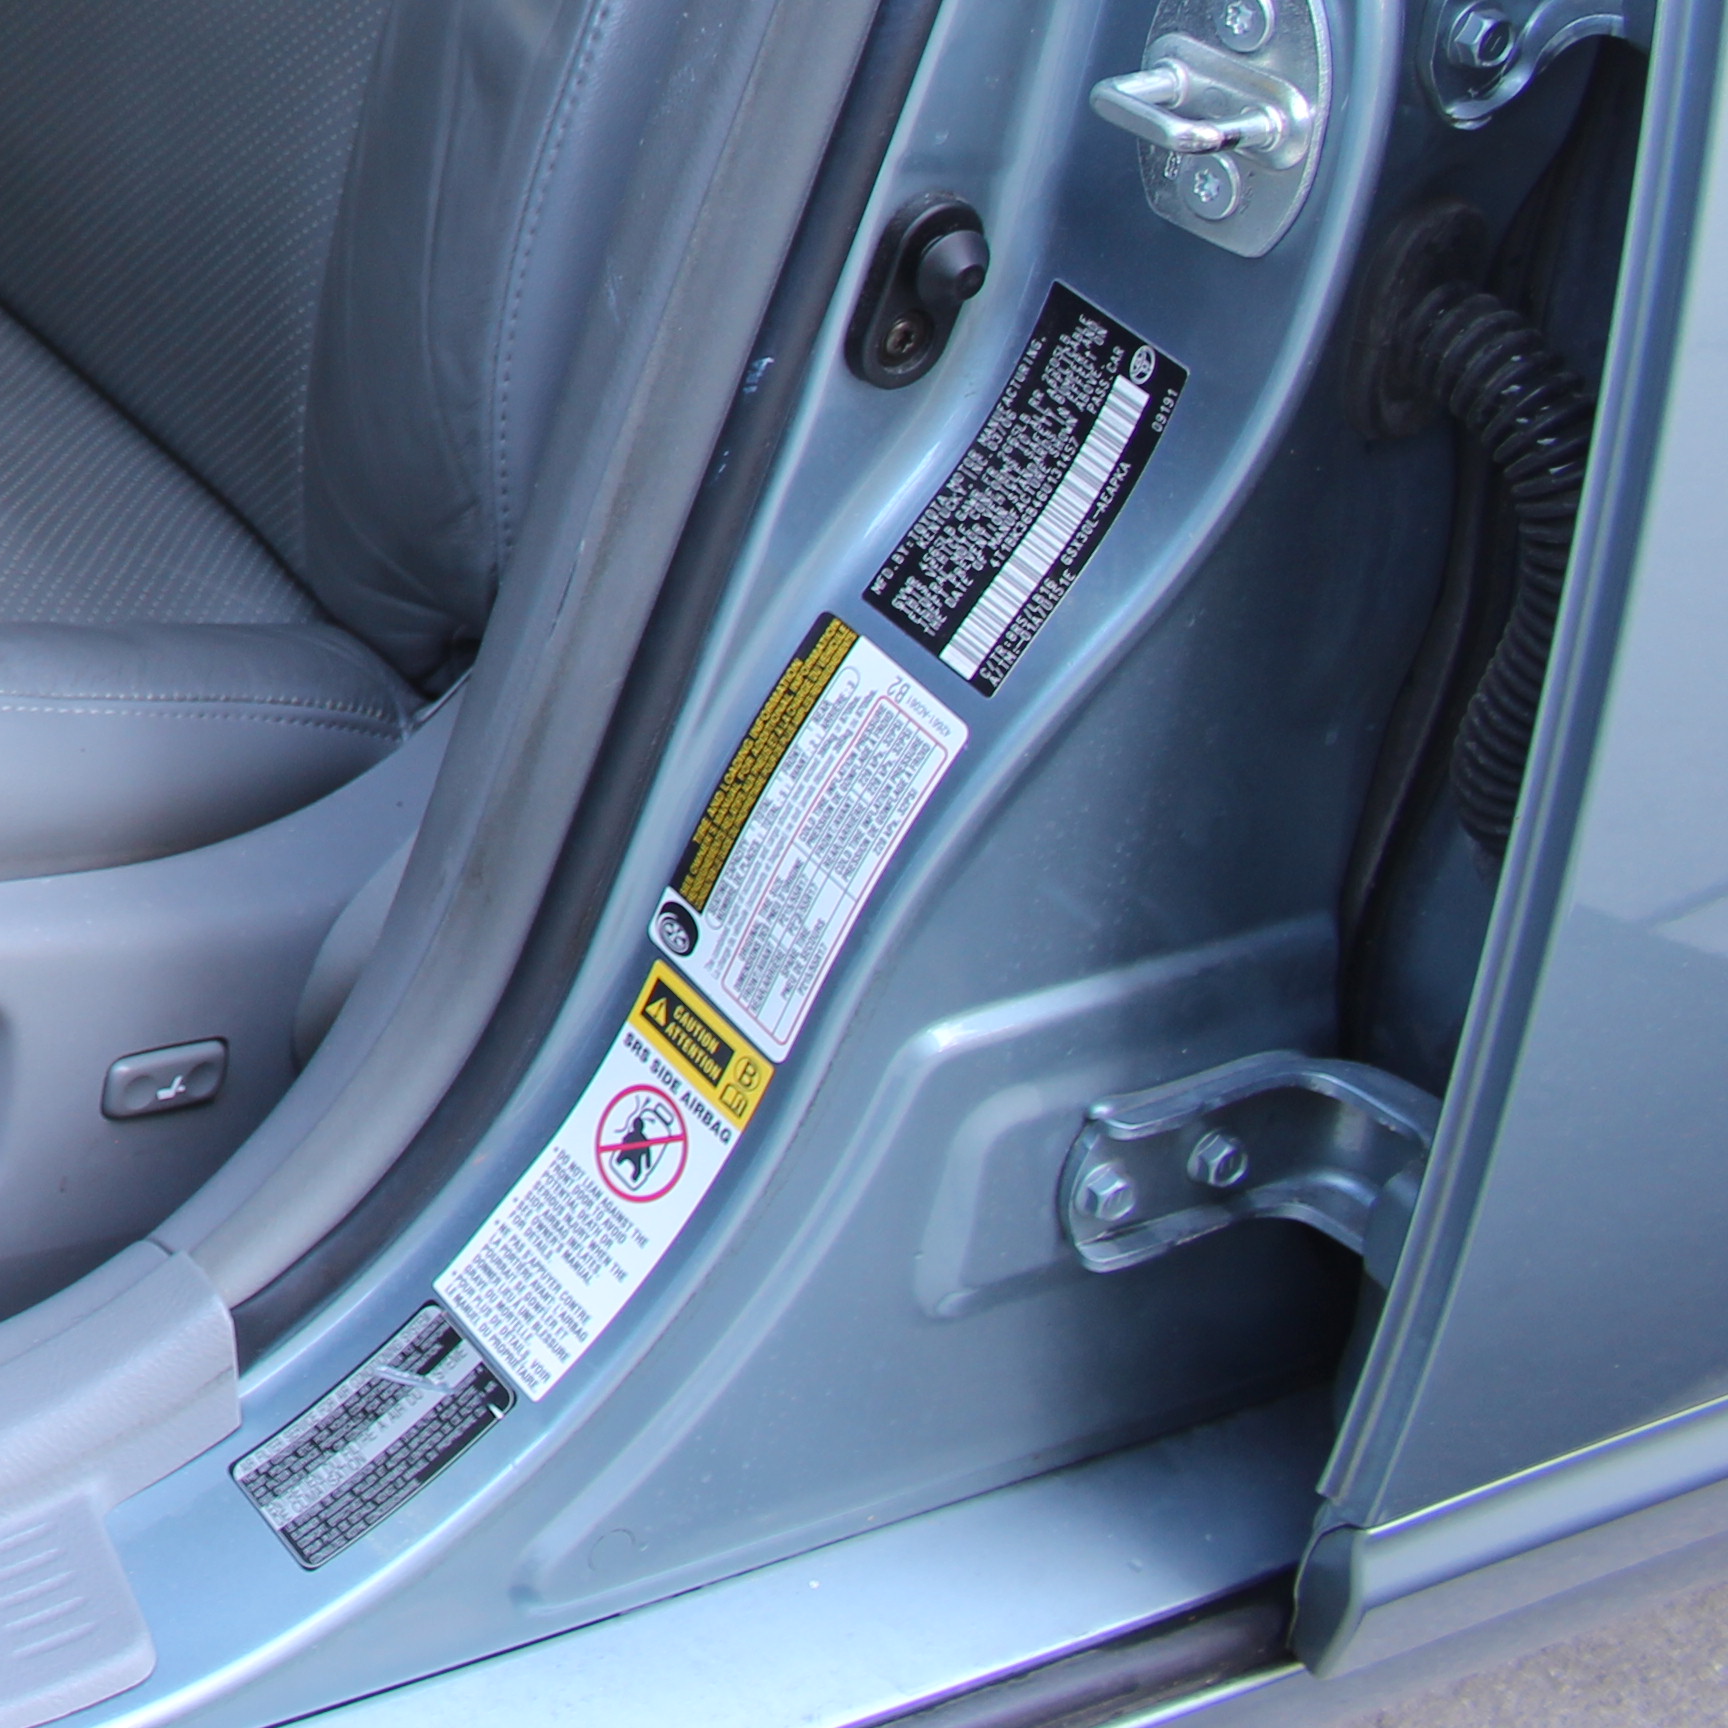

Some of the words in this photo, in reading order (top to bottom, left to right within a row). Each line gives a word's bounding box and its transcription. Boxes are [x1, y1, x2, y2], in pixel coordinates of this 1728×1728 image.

[1150, 385, 1178, 434] 09191
[923, 607, 948, 638] THE
[943, 573, 975, 609] DATE
[971, 551, 990, 572] OF
[986, 460, 1052, 551] MANUFACTURE
[1047, 412, 1078, 459] SHOWN
[886, 675, 911, 704] B2
[664, 1019, 723, 1083] ATTENTION
[672, 1002, 719, 1056] CAUTION
[622, 1030, 651, 1064] SRS
[648, 1056, 683, 1095] SIDE
[680, 1088, 734, 1146] AIRBAG
[507, 1209, 526, 1231] FOR
[523, 1190, 544, 1213] SIDE
[540, 1208, 569, 1240] AIRBAG
[539, 1169, 579, 1213] POTENTIAL
[576, 1208, 602, 1237] DEATH
[599, 1232, 614, 1249] OR
[548, 1159, 574, 1189] FRONT
[571, 1183, 595, 1210] DOOR
[591, 1204, 605, 1222] TO
[601, 1215, 628, 1246] AVOID
[556, 1148, 571, 1166] DO
[567, 1160, 585, 1182] NOT
[581, 1175, 603, 1201] LEAN
[599, 1194, 634, 1232] AGAINST
[630, 1226, 649, 1249] THE
[488, 1232, 502, 1248] LA
[516, 1199, 532, 1219] SEE
[530, 1215, 564, 1253] OWNER'S
[560, 1248, 594, 1286] MANUAL
[531, 1179, 565, 1217] SERIOUS
[561, 1211, 590, 1243] INJURY
[586, 1238, 612, 1267] WHEN
[609, 1262, 628, 1284] THE
[444, 1283, 457, 1297] LE
[497, 1222, 511, 1238] NE
[507, 1233, 525, 1254] PAS
[558, 1289, 591, 1326] CONTRE
[453, 1273, 476, 1299] POUR
[471, 1293, 493, 1318] PLUS
[488, 1313, 503, 1330] DE
[528, 1359, 551, 1384] VOIR
[516, 1304, 535, 1325] UNE
[530, 1319, 570, 1364] BLESSURE
[554, 1325, 568, 1341] ET
